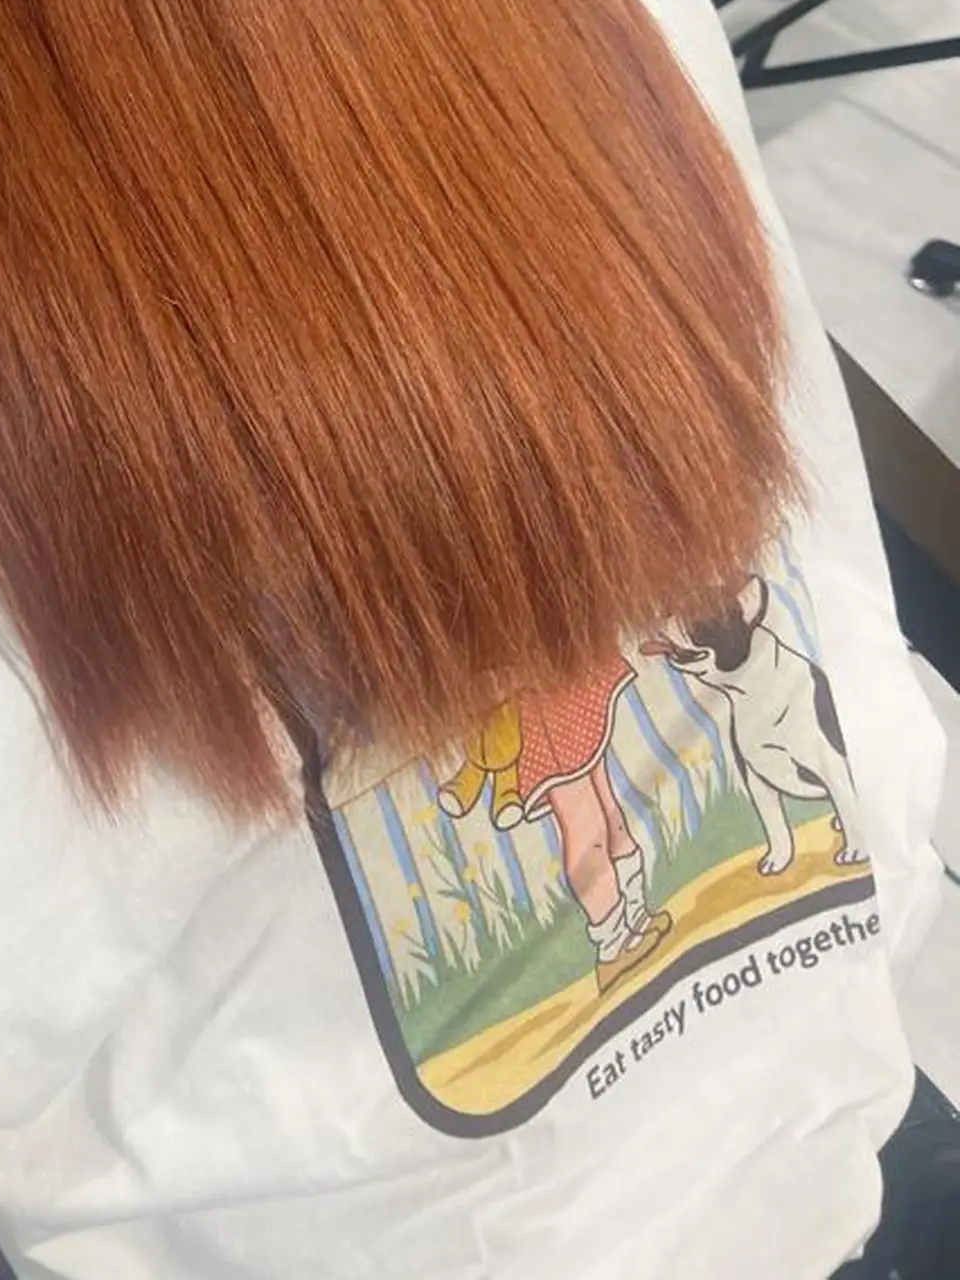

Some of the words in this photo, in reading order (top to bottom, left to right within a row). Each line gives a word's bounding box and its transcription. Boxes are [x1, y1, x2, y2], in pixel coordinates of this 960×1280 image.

[586, 1051, 626, 1100] Eat
[630, 999, 687, 1062] tasty
[692, 955, 763, 1013] food
